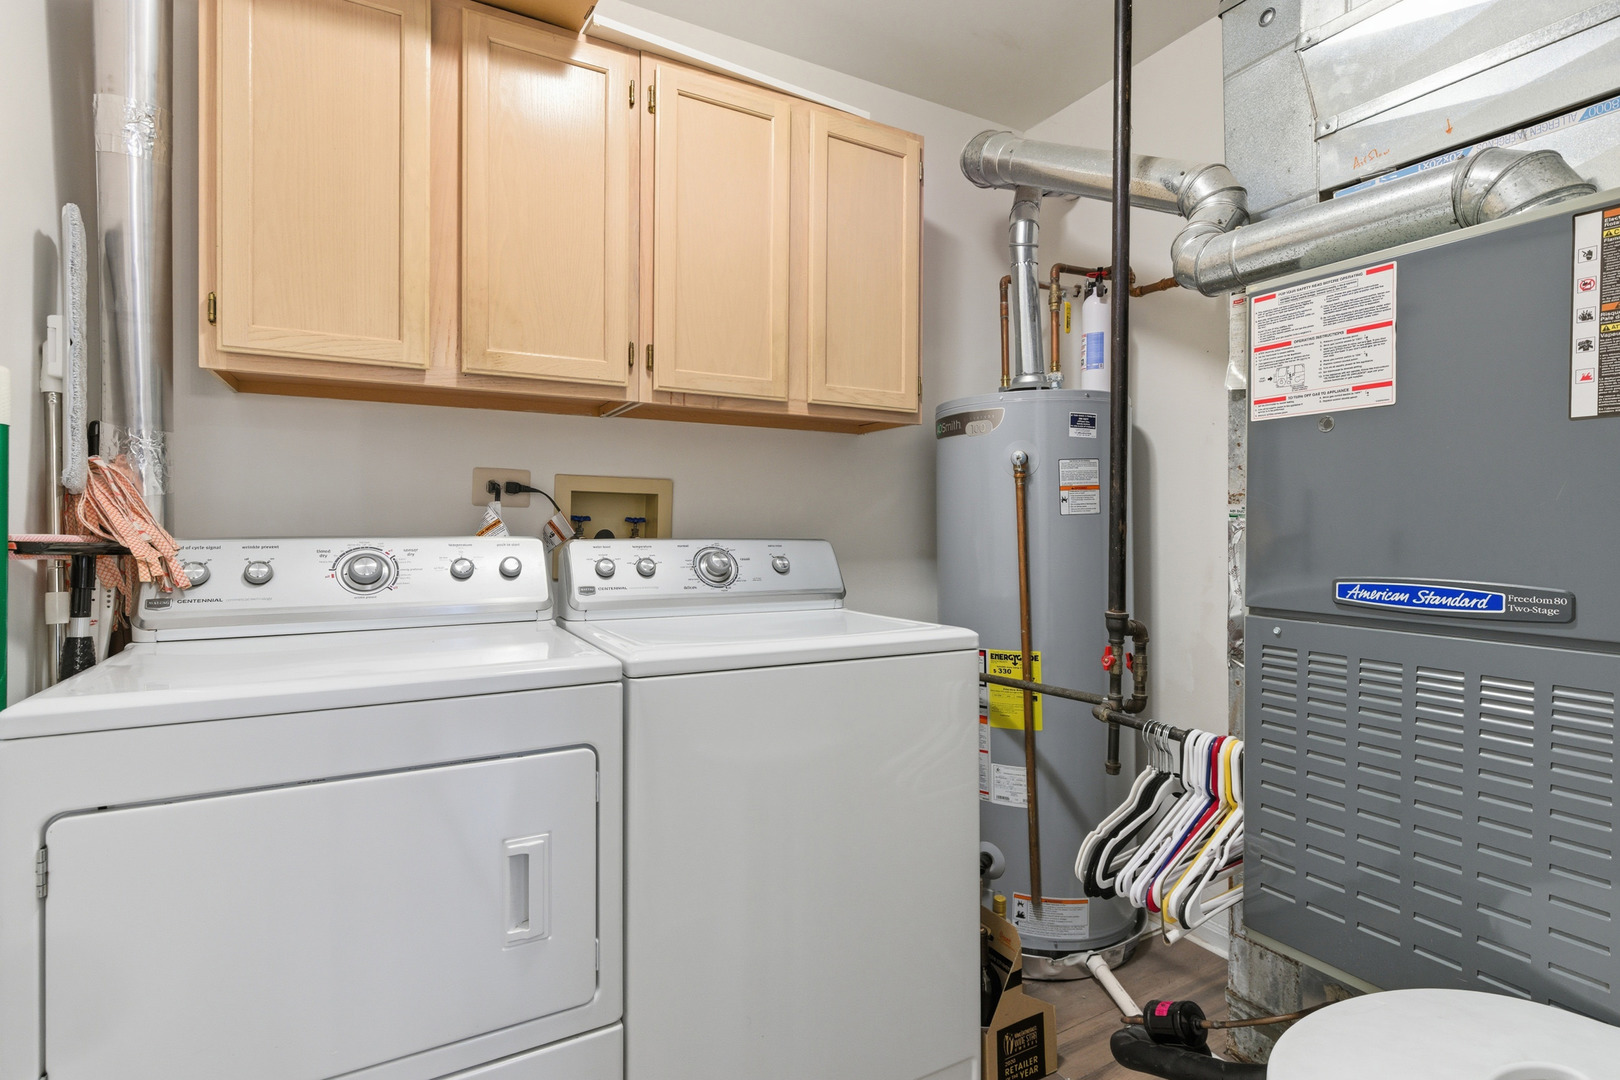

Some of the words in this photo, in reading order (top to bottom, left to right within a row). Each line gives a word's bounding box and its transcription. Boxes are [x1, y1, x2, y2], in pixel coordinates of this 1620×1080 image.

[1529, 112, 1578, 138] ALLERGEN
[1344, 584, 1409, 603] American
[1412, 590, 1491, 609] Standard
[1508, 594, 1553, 605] Freedom
[1553, 597, 1568, 606] 80
[1507, 604, 1560, 616] Two-Stage
[990, 653, 1039, 662] ENERGYGDE
[1004, 1055, 1038, 1076] RETAILER
[1019, 1065, 1039, 1079] YEAR
